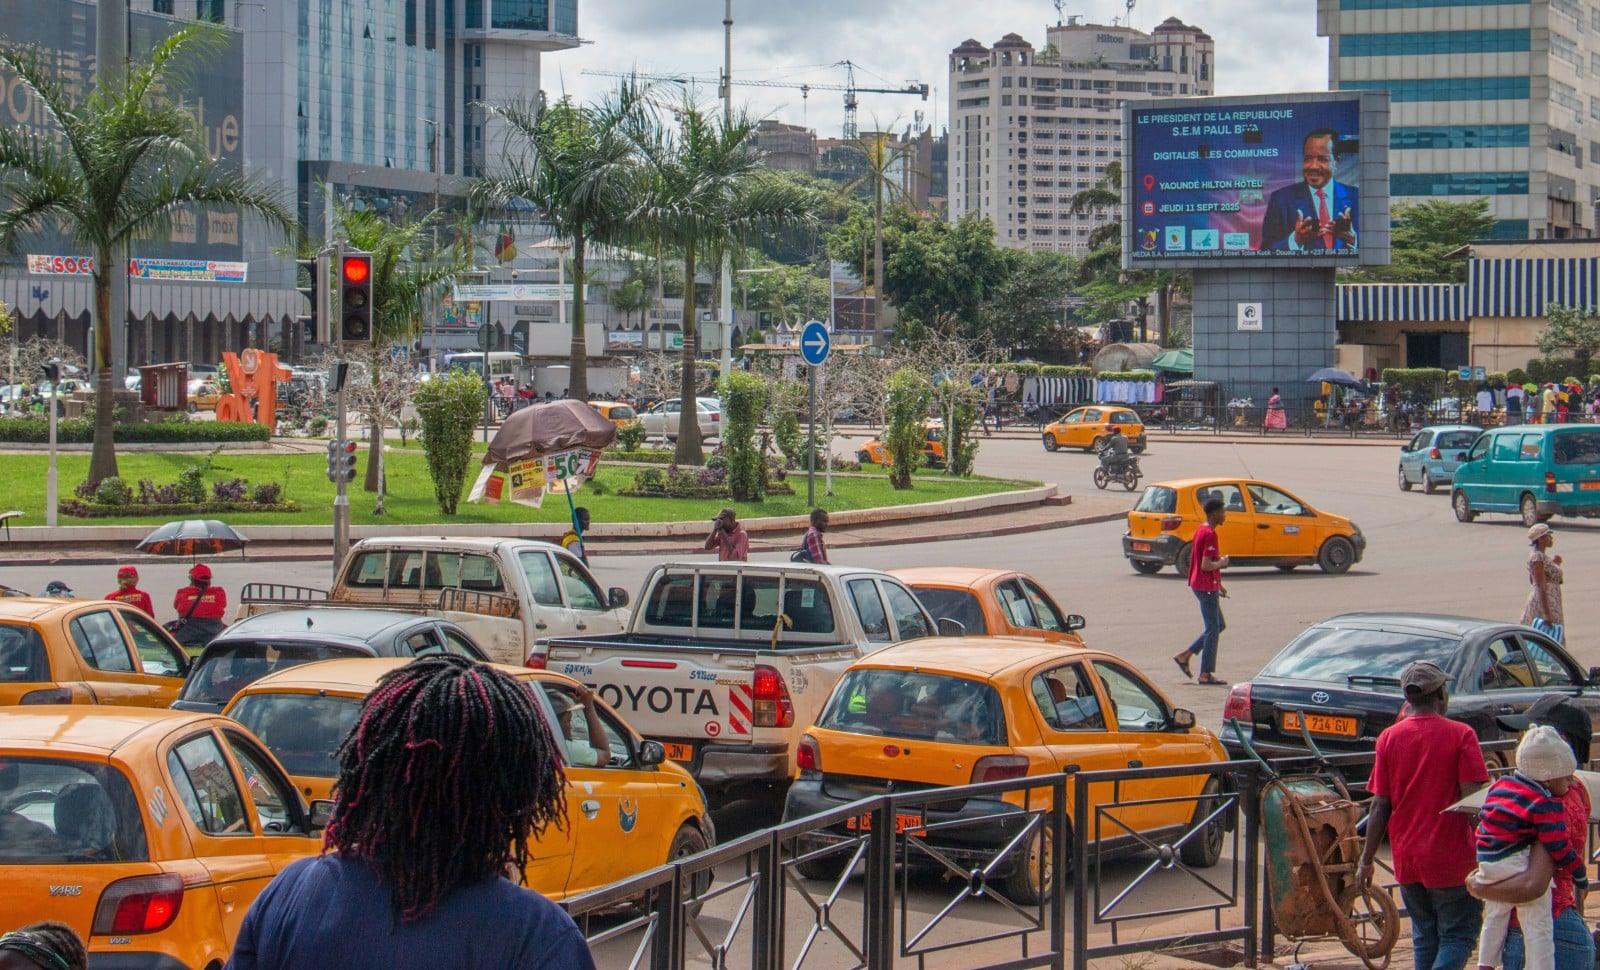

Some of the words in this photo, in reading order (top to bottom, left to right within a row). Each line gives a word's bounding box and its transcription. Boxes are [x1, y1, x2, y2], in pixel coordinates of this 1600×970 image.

[1097, 33, 1124, 44] Hilton
[1138, 115, 1149, 124] LE
[1151, 113, 1201, 124] PRESIDENT
[1203, 112, 1217, 122] DE
[1218, 111, 1231, 121] LA
[1232, 109, 1293, 121] REPUBLIQUE
[1172, 126, 1201, 137] S.E.M
[1203, 124, 1232, 135] PAUL
[1224, 148, 1278, 159] COMMUNES
[1160, 179, 1200, 190] YAOUNDÉ
[1201, 180, 1232, 189] HILTON
[1159, 204, 1184, 213] JEUDI
[1186, 204, 1195, 212] 11
[1196, 203, 1219, 212] SEPT
[1220, 202, 1240, 211] 2025
[211, 220, 235, 234] max
[1312, 717, 1331, 732] 714
[1335, 719, 1349, 732] GV
[669, 745, 684, 760] JN
[49, 885, 82, 896] YARIS
